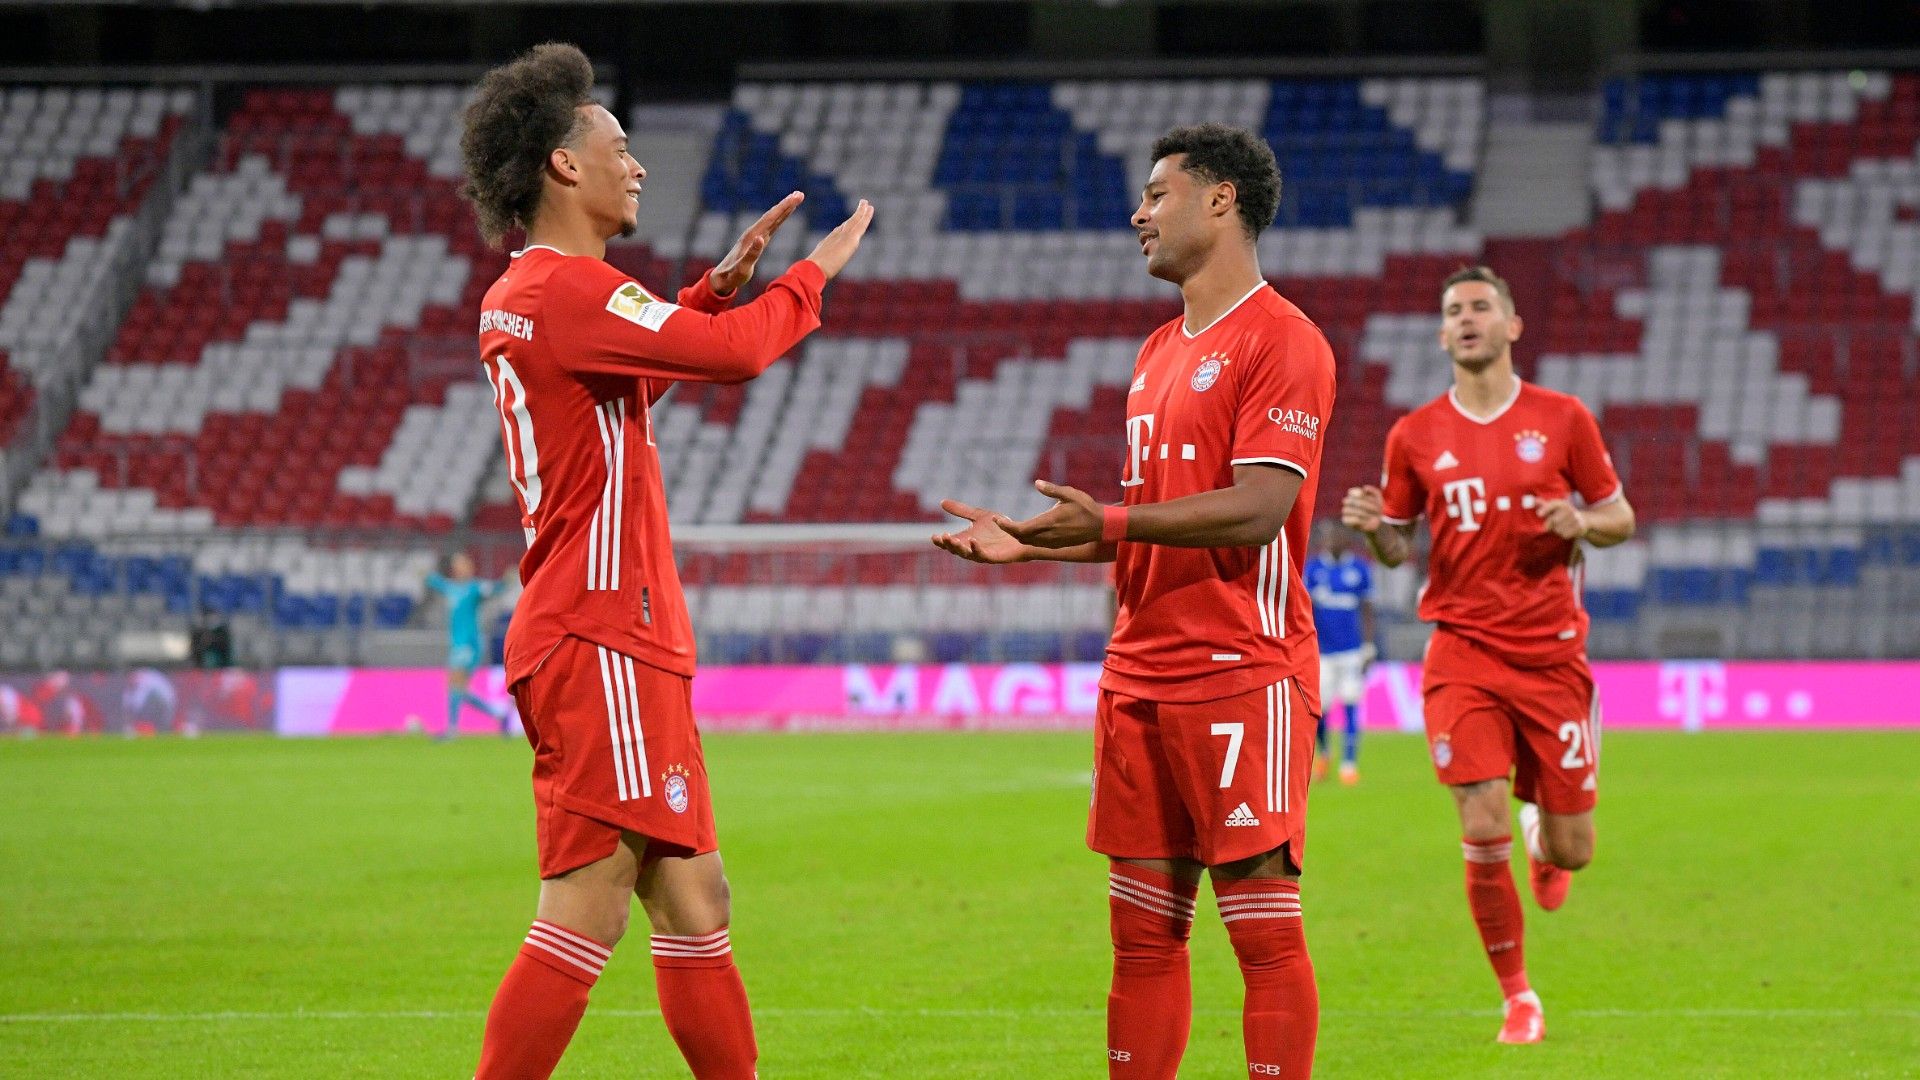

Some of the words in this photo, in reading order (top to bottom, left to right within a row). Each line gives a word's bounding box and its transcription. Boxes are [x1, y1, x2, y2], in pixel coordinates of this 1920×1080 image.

[1268, 407, 1320, 432] QATAR
[1280, 423, 1317, 441] AIRWAYS
[1210, 722, 1245, 788] 7
[1107, 1047, 1131, 1062] CB
[1249, 1062, 1280, 1076] FCB
